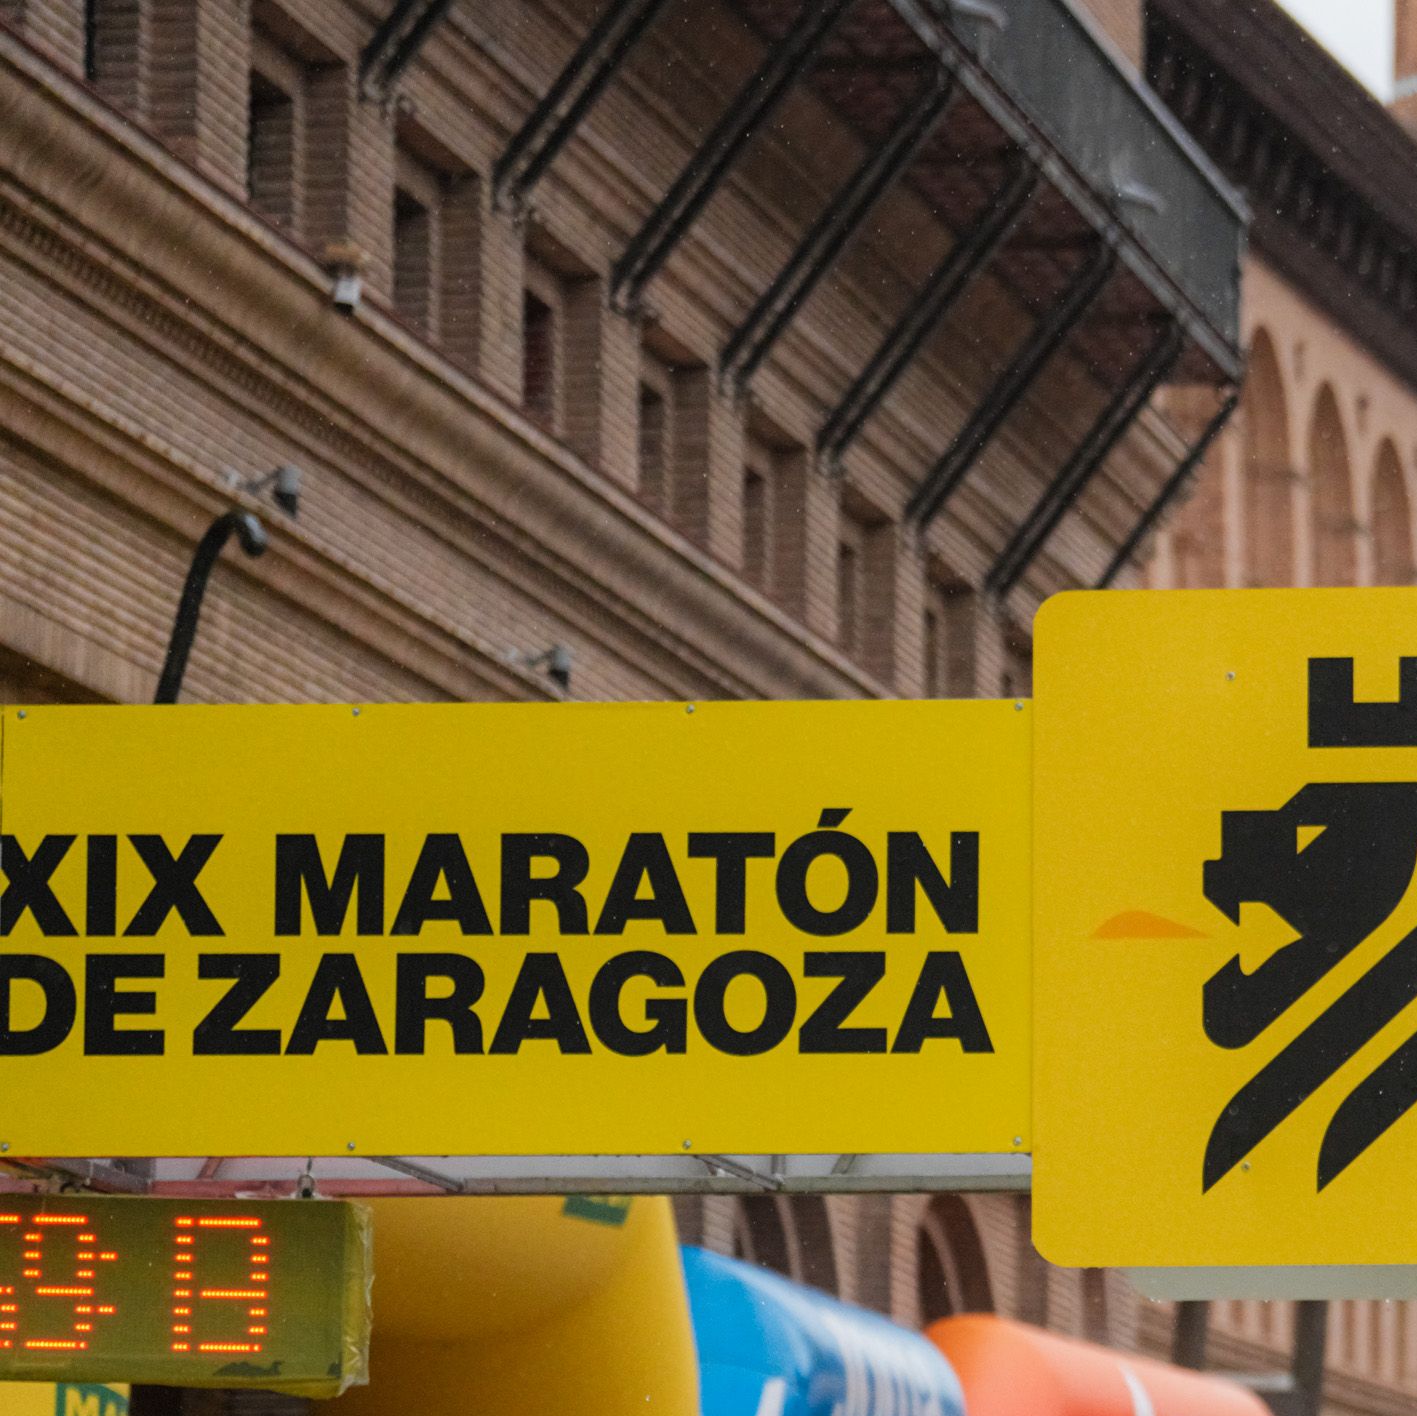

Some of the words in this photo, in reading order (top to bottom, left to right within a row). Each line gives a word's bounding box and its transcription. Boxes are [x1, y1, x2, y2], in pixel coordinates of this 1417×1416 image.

[0, 833, 225, 936] XIX
[275, 807, 980, 936] MARATÓN
[0, 953, 165, 1056] DE
[192, 949, 994, 1056] ZARAGOZA
